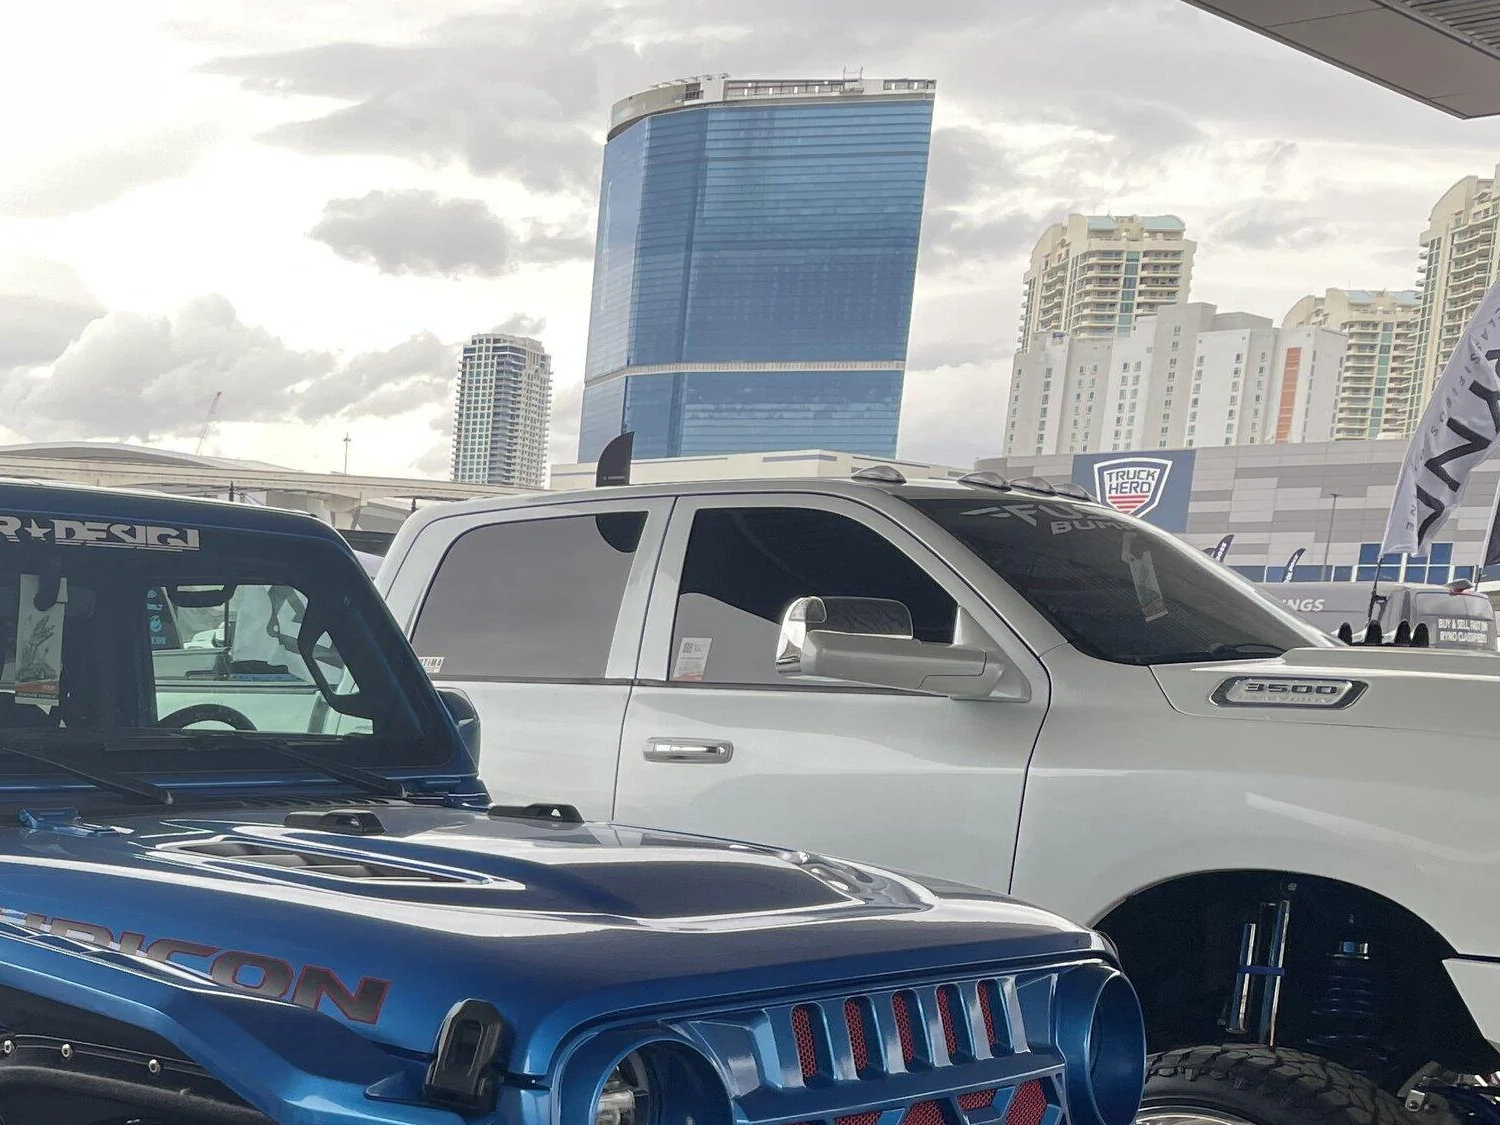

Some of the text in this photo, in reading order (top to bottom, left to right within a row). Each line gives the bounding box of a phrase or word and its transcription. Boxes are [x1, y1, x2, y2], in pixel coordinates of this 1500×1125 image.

[1105, 469, 1158, 482] TRUCK
[1107, 482, 1153, 495] HERD
[49, 519, 201, 553] DESIGN
[1438, 618, 1451, 629] BUY
[419, 658, 443, 667] PTIMA
[1245, 683, 1338, 695] 3500
